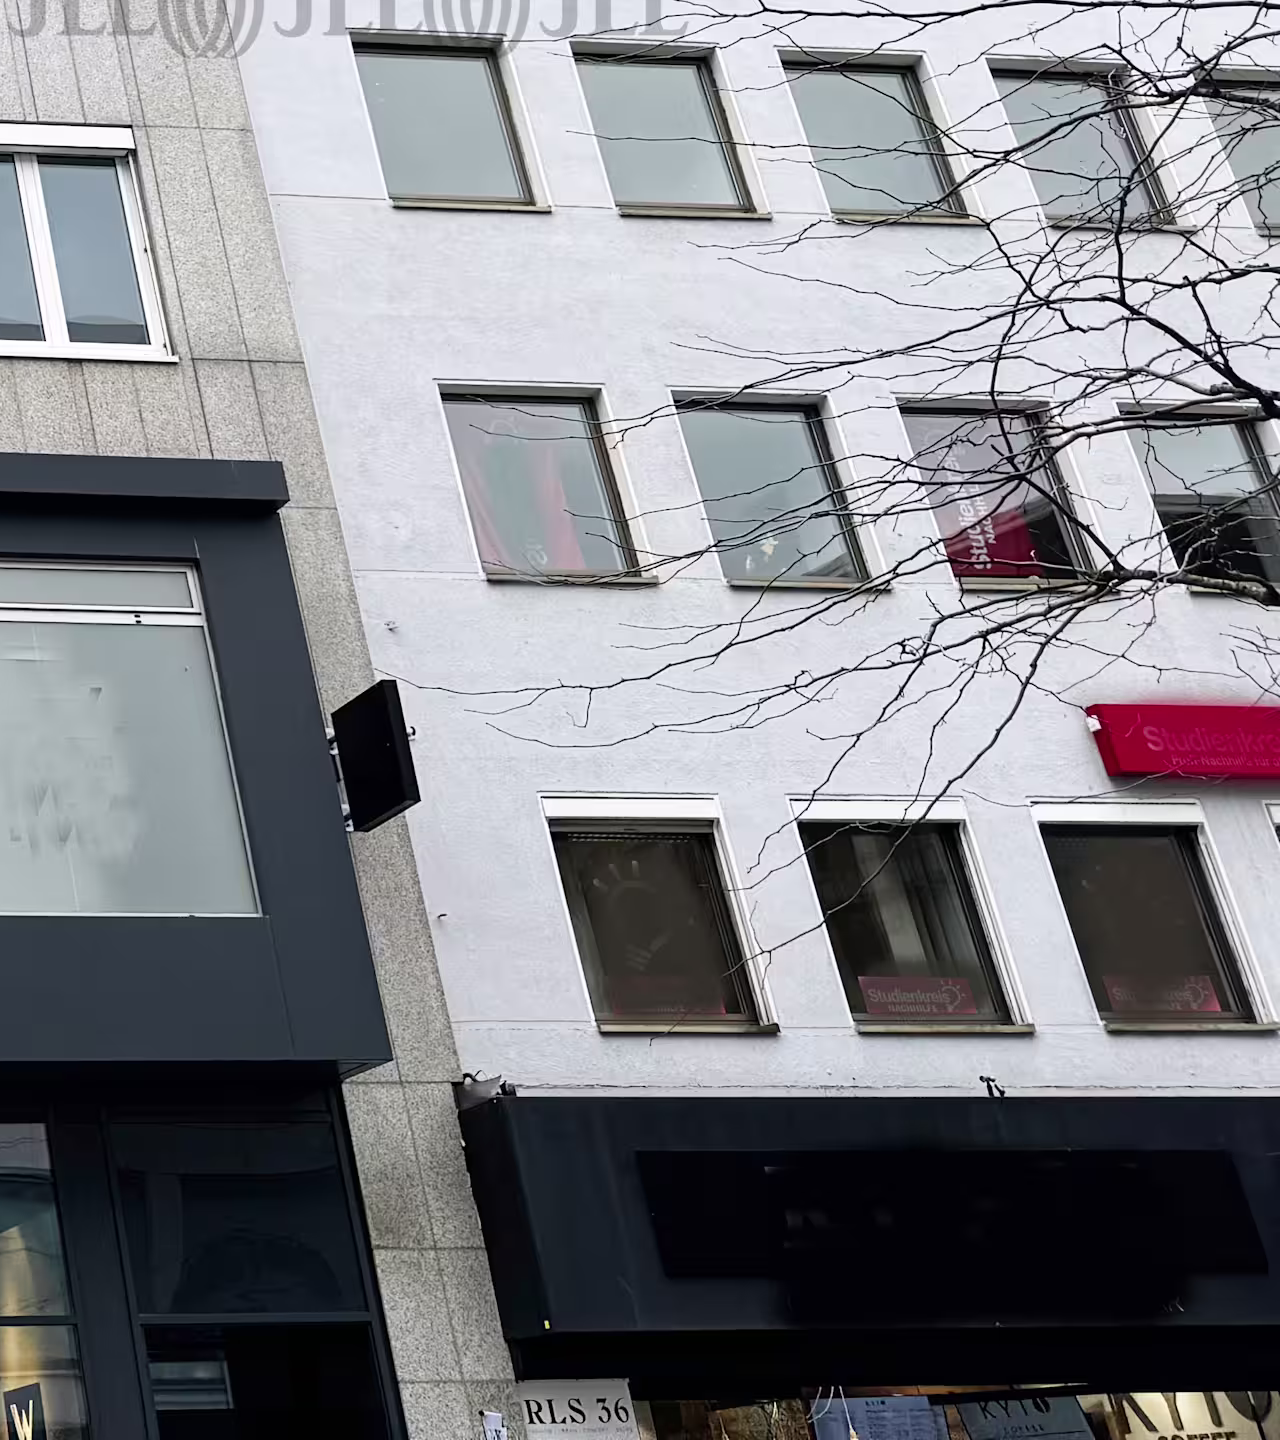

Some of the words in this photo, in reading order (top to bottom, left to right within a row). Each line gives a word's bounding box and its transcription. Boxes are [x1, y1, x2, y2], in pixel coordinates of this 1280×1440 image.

[868, 985, 950, 1003] Studienkreis
[523, 1398, 587, 1425] RLS
[596, 1397, 630, 1424] 36
